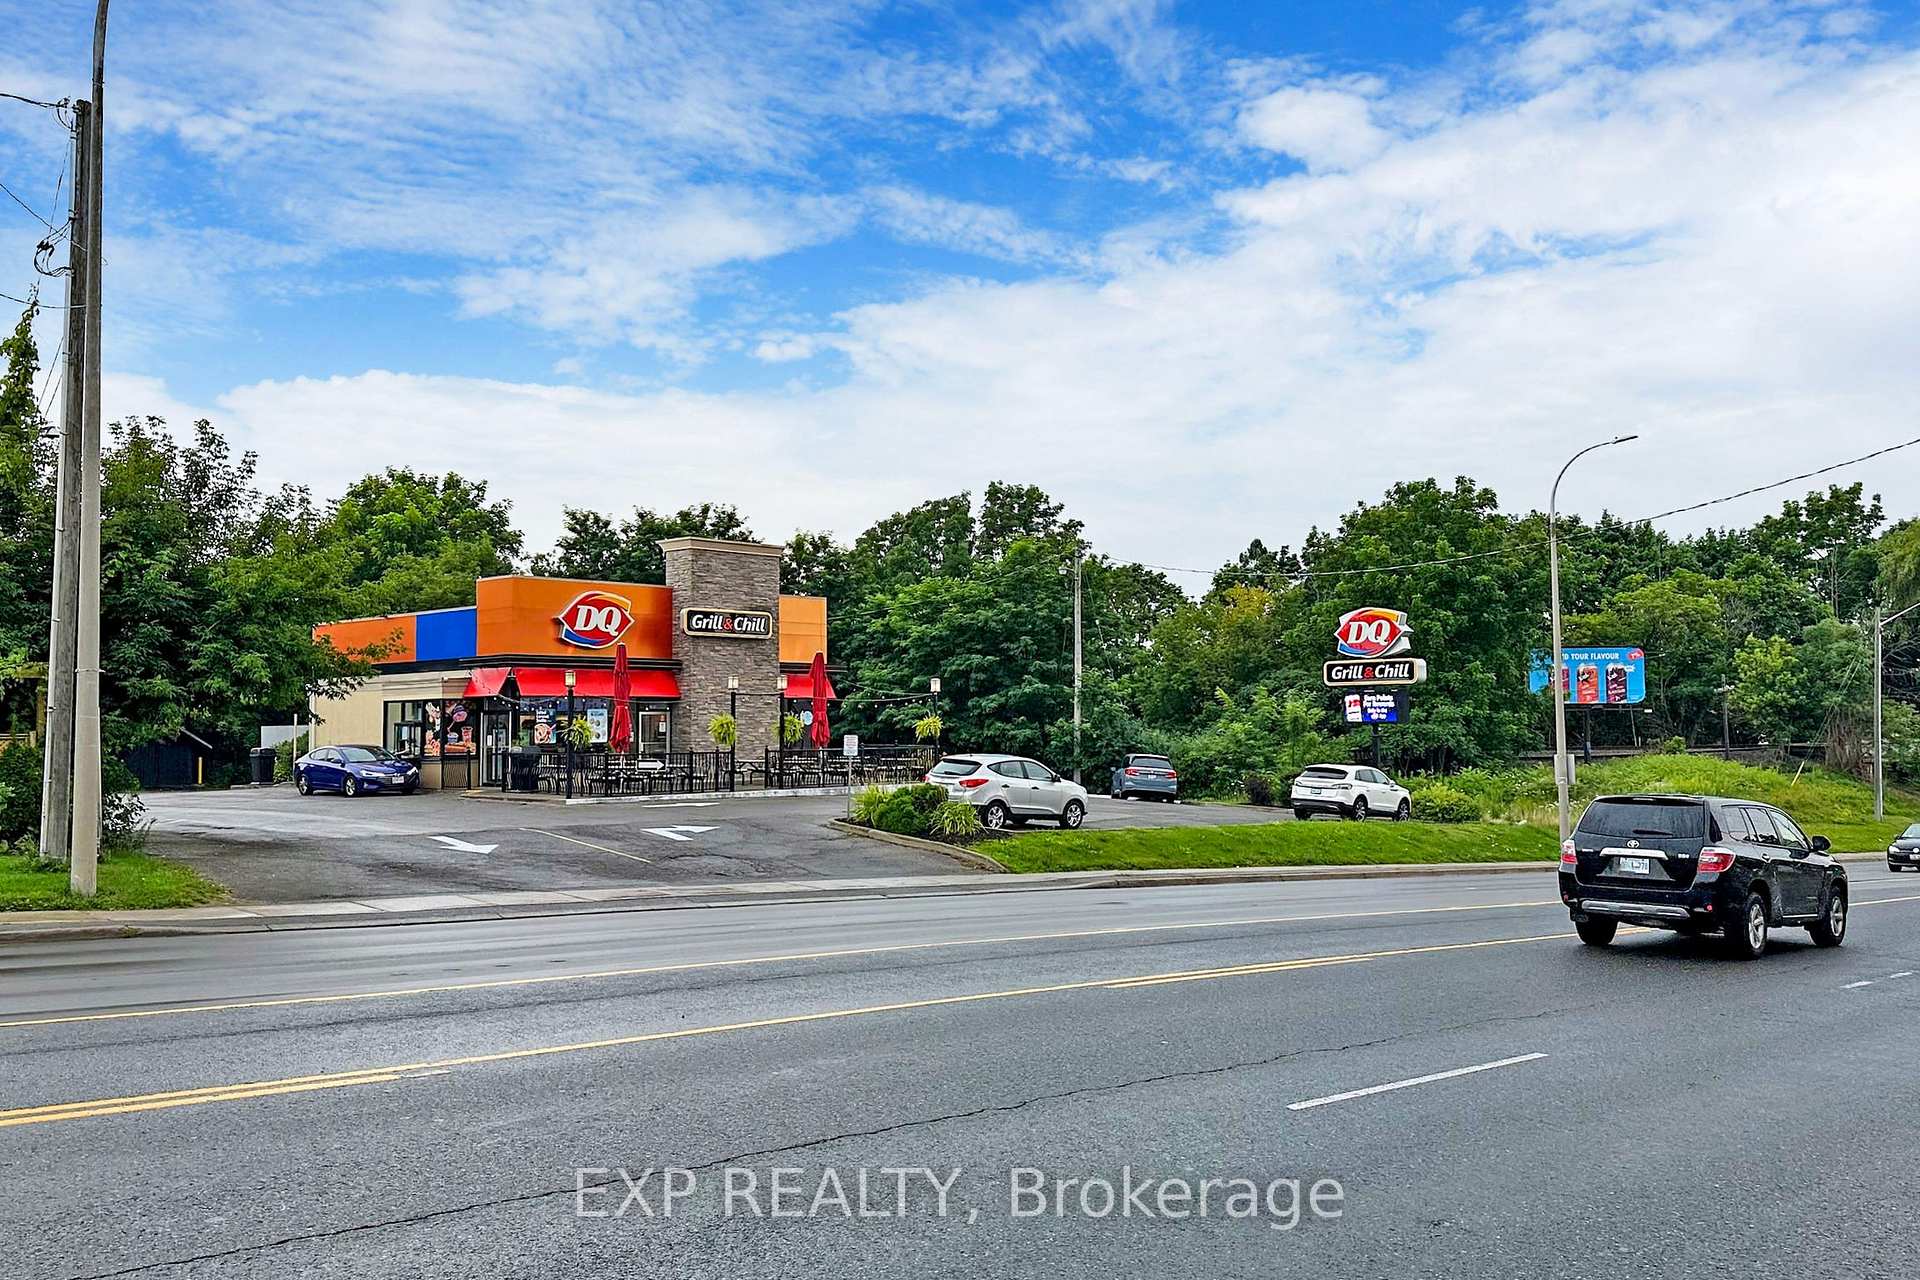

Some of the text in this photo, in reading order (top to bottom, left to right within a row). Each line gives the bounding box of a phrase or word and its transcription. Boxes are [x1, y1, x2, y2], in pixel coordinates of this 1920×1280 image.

[574, 605, 621, 635] DQ
[1347, 619, 1391, 645] DQ
[1591, 652, 1619, 660] FLAVOUR
